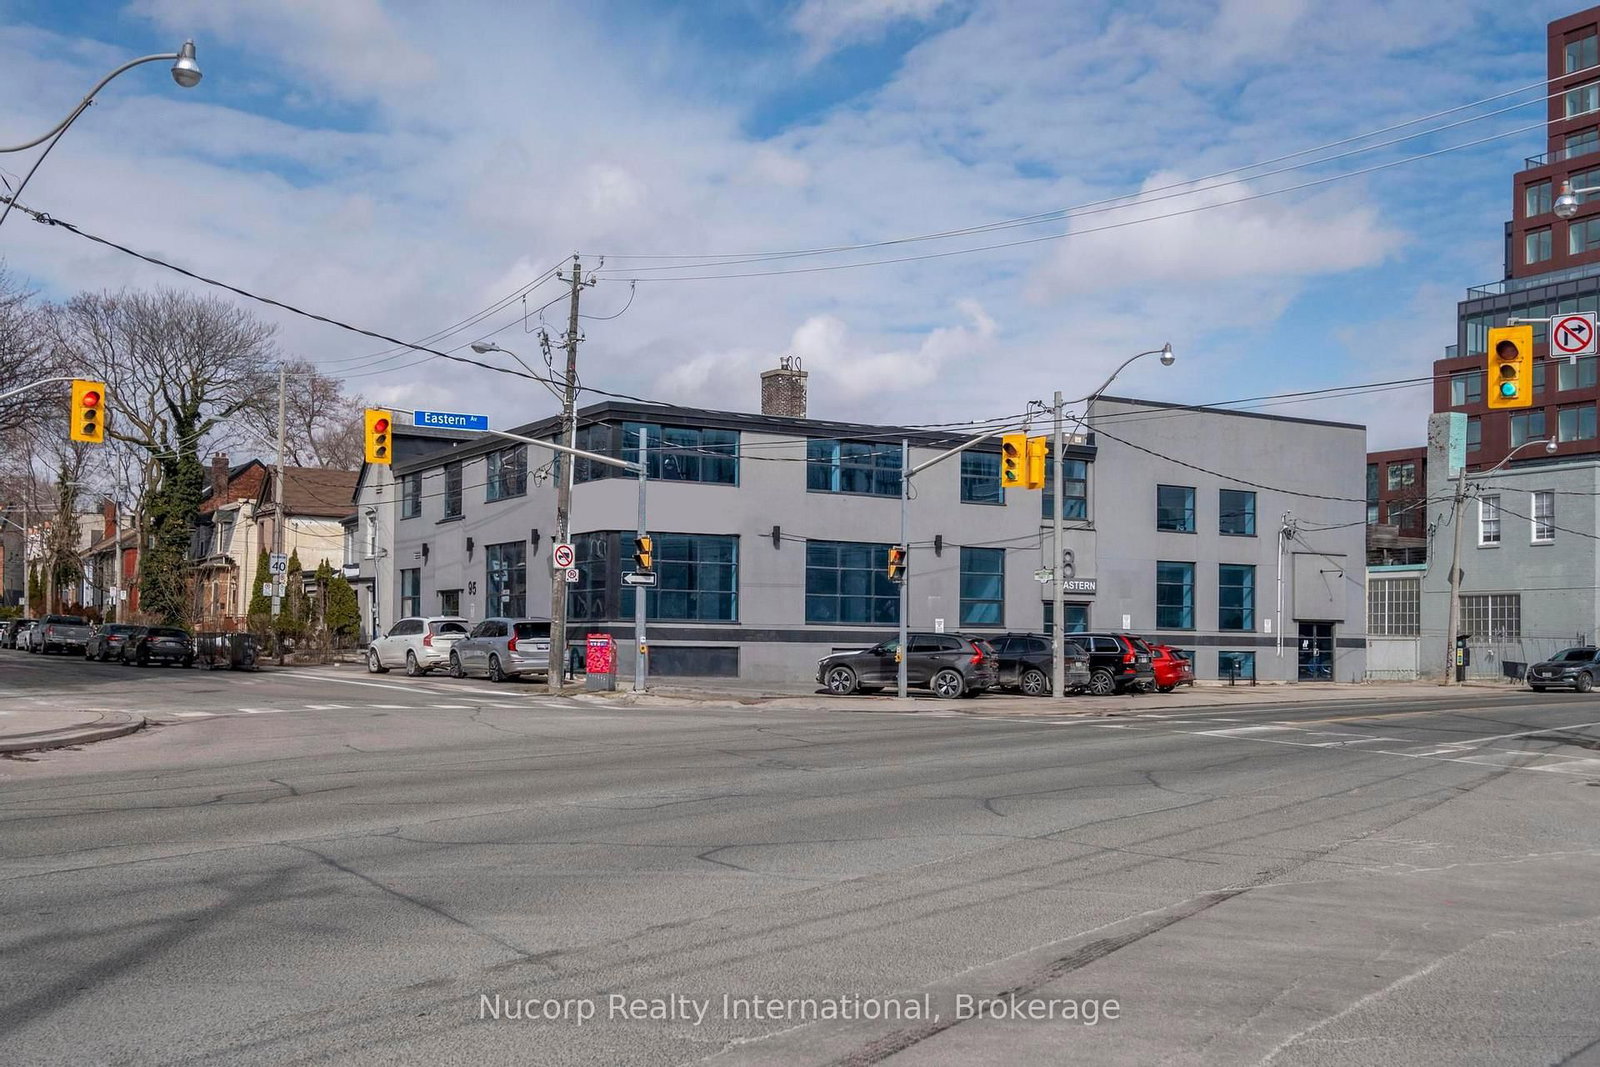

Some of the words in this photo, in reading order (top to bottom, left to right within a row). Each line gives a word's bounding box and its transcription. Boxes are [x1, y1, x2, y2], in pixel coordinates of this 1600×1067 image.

[424, 412, 466, 426] Eastern
[271, 561, 286, 571] 40
[468, 580, 477, 595] 95
[1062, 581, 1096, 590] ASTERN
